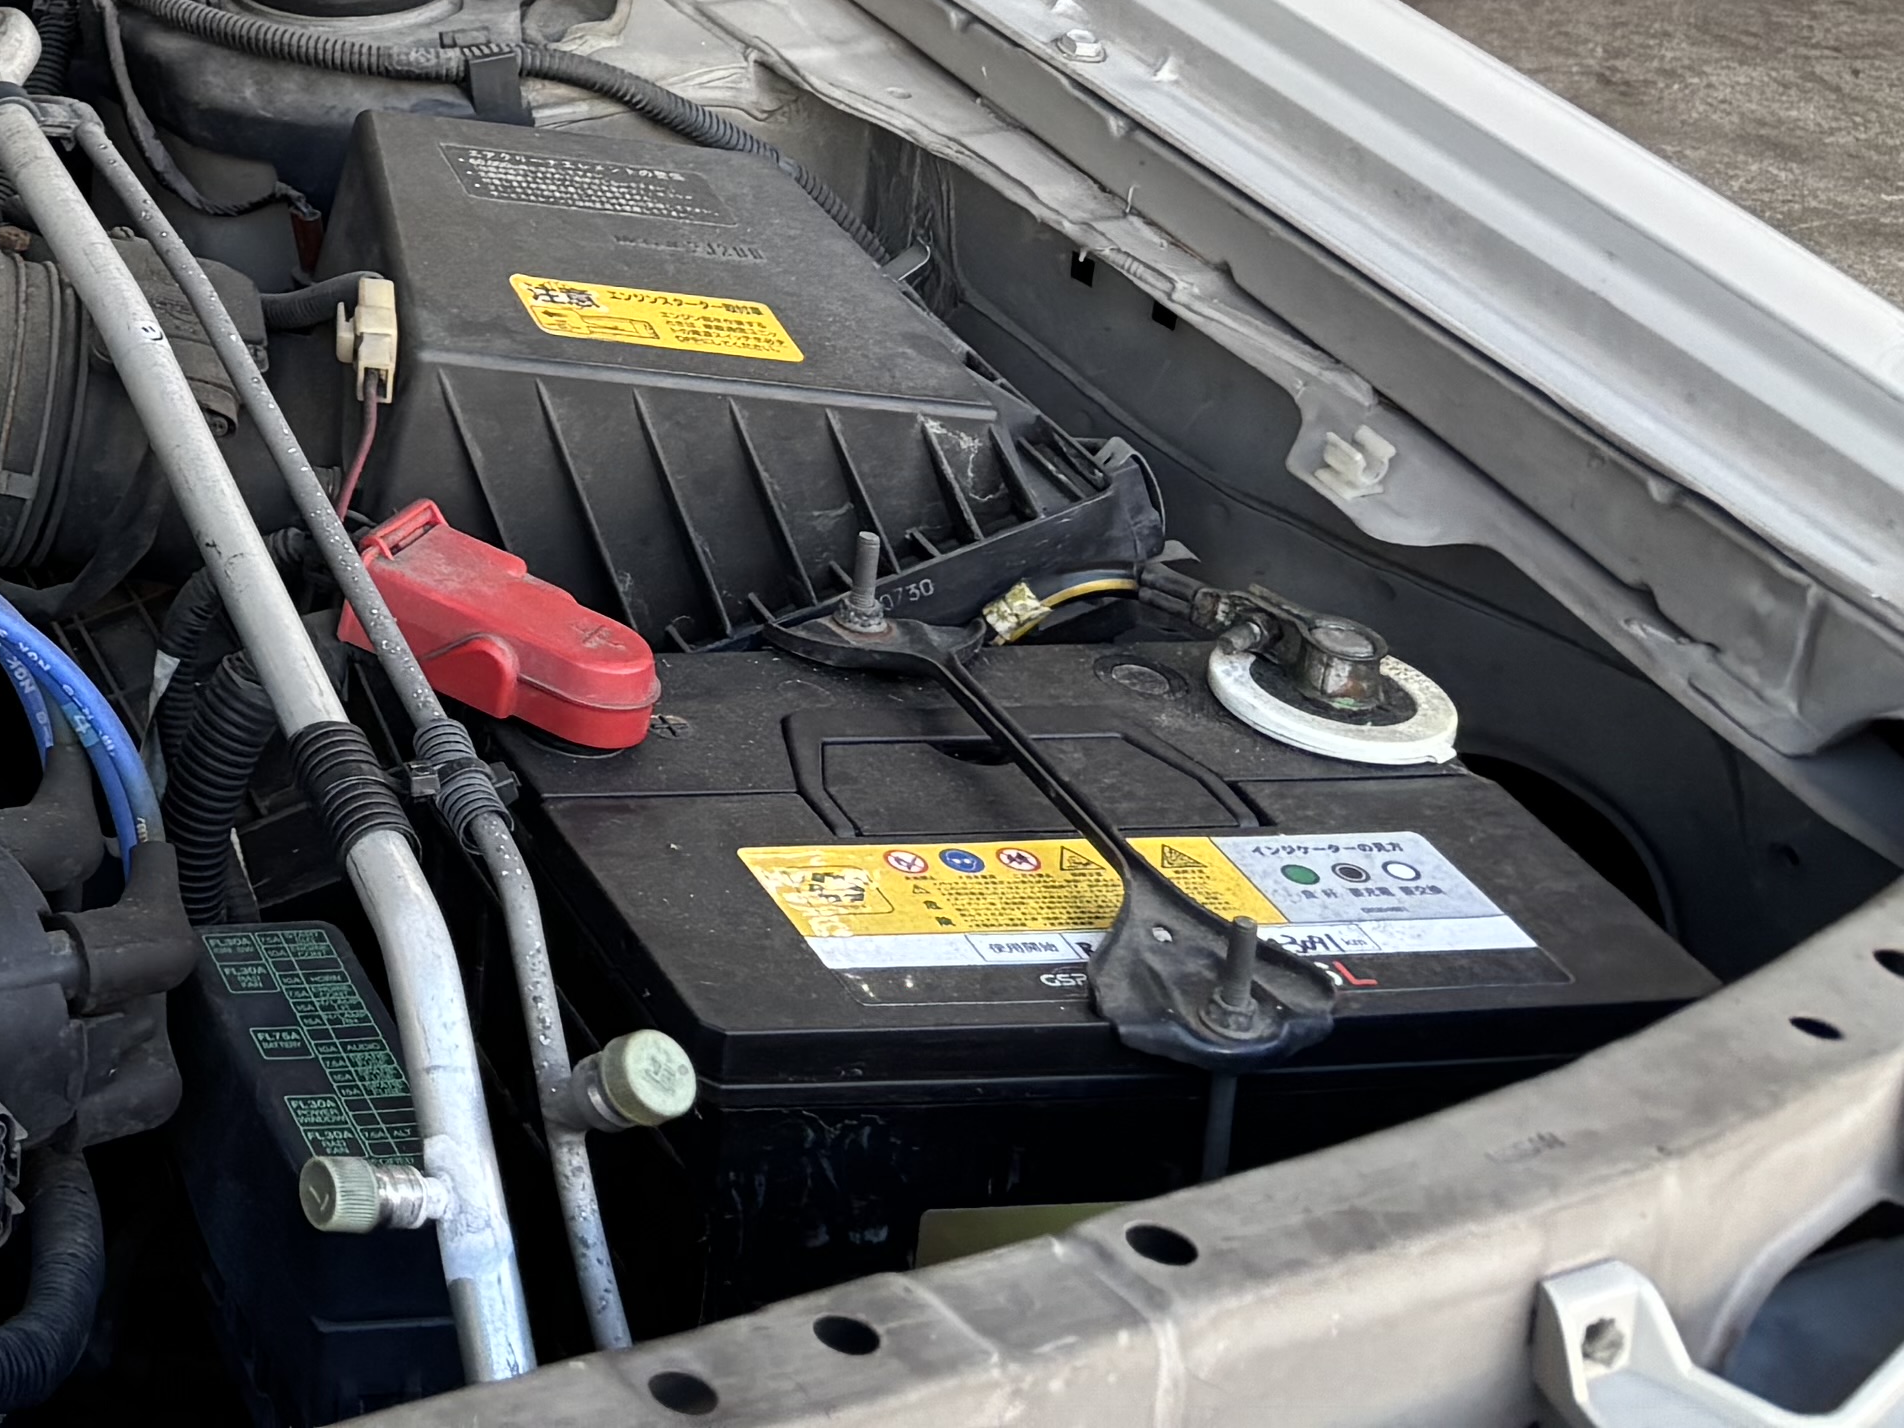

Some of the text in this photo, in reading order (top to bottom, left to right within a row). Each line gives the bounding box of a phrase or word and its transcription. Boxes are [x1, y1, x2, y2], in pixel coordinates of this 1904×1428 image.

[527, 282, 600, 309] 注意
[6, 656, 35, 694] NGK
[73, 714, 91, 734] 4
[1252, 841, 1406, 856] インジケーターの見方
[1342, 936, 1368, 948] km
[224, 966, 267, 975] FL30A
[291, 1099, 336, 1108] FL30A
[307, 1131, 353, 1140] FL30A
